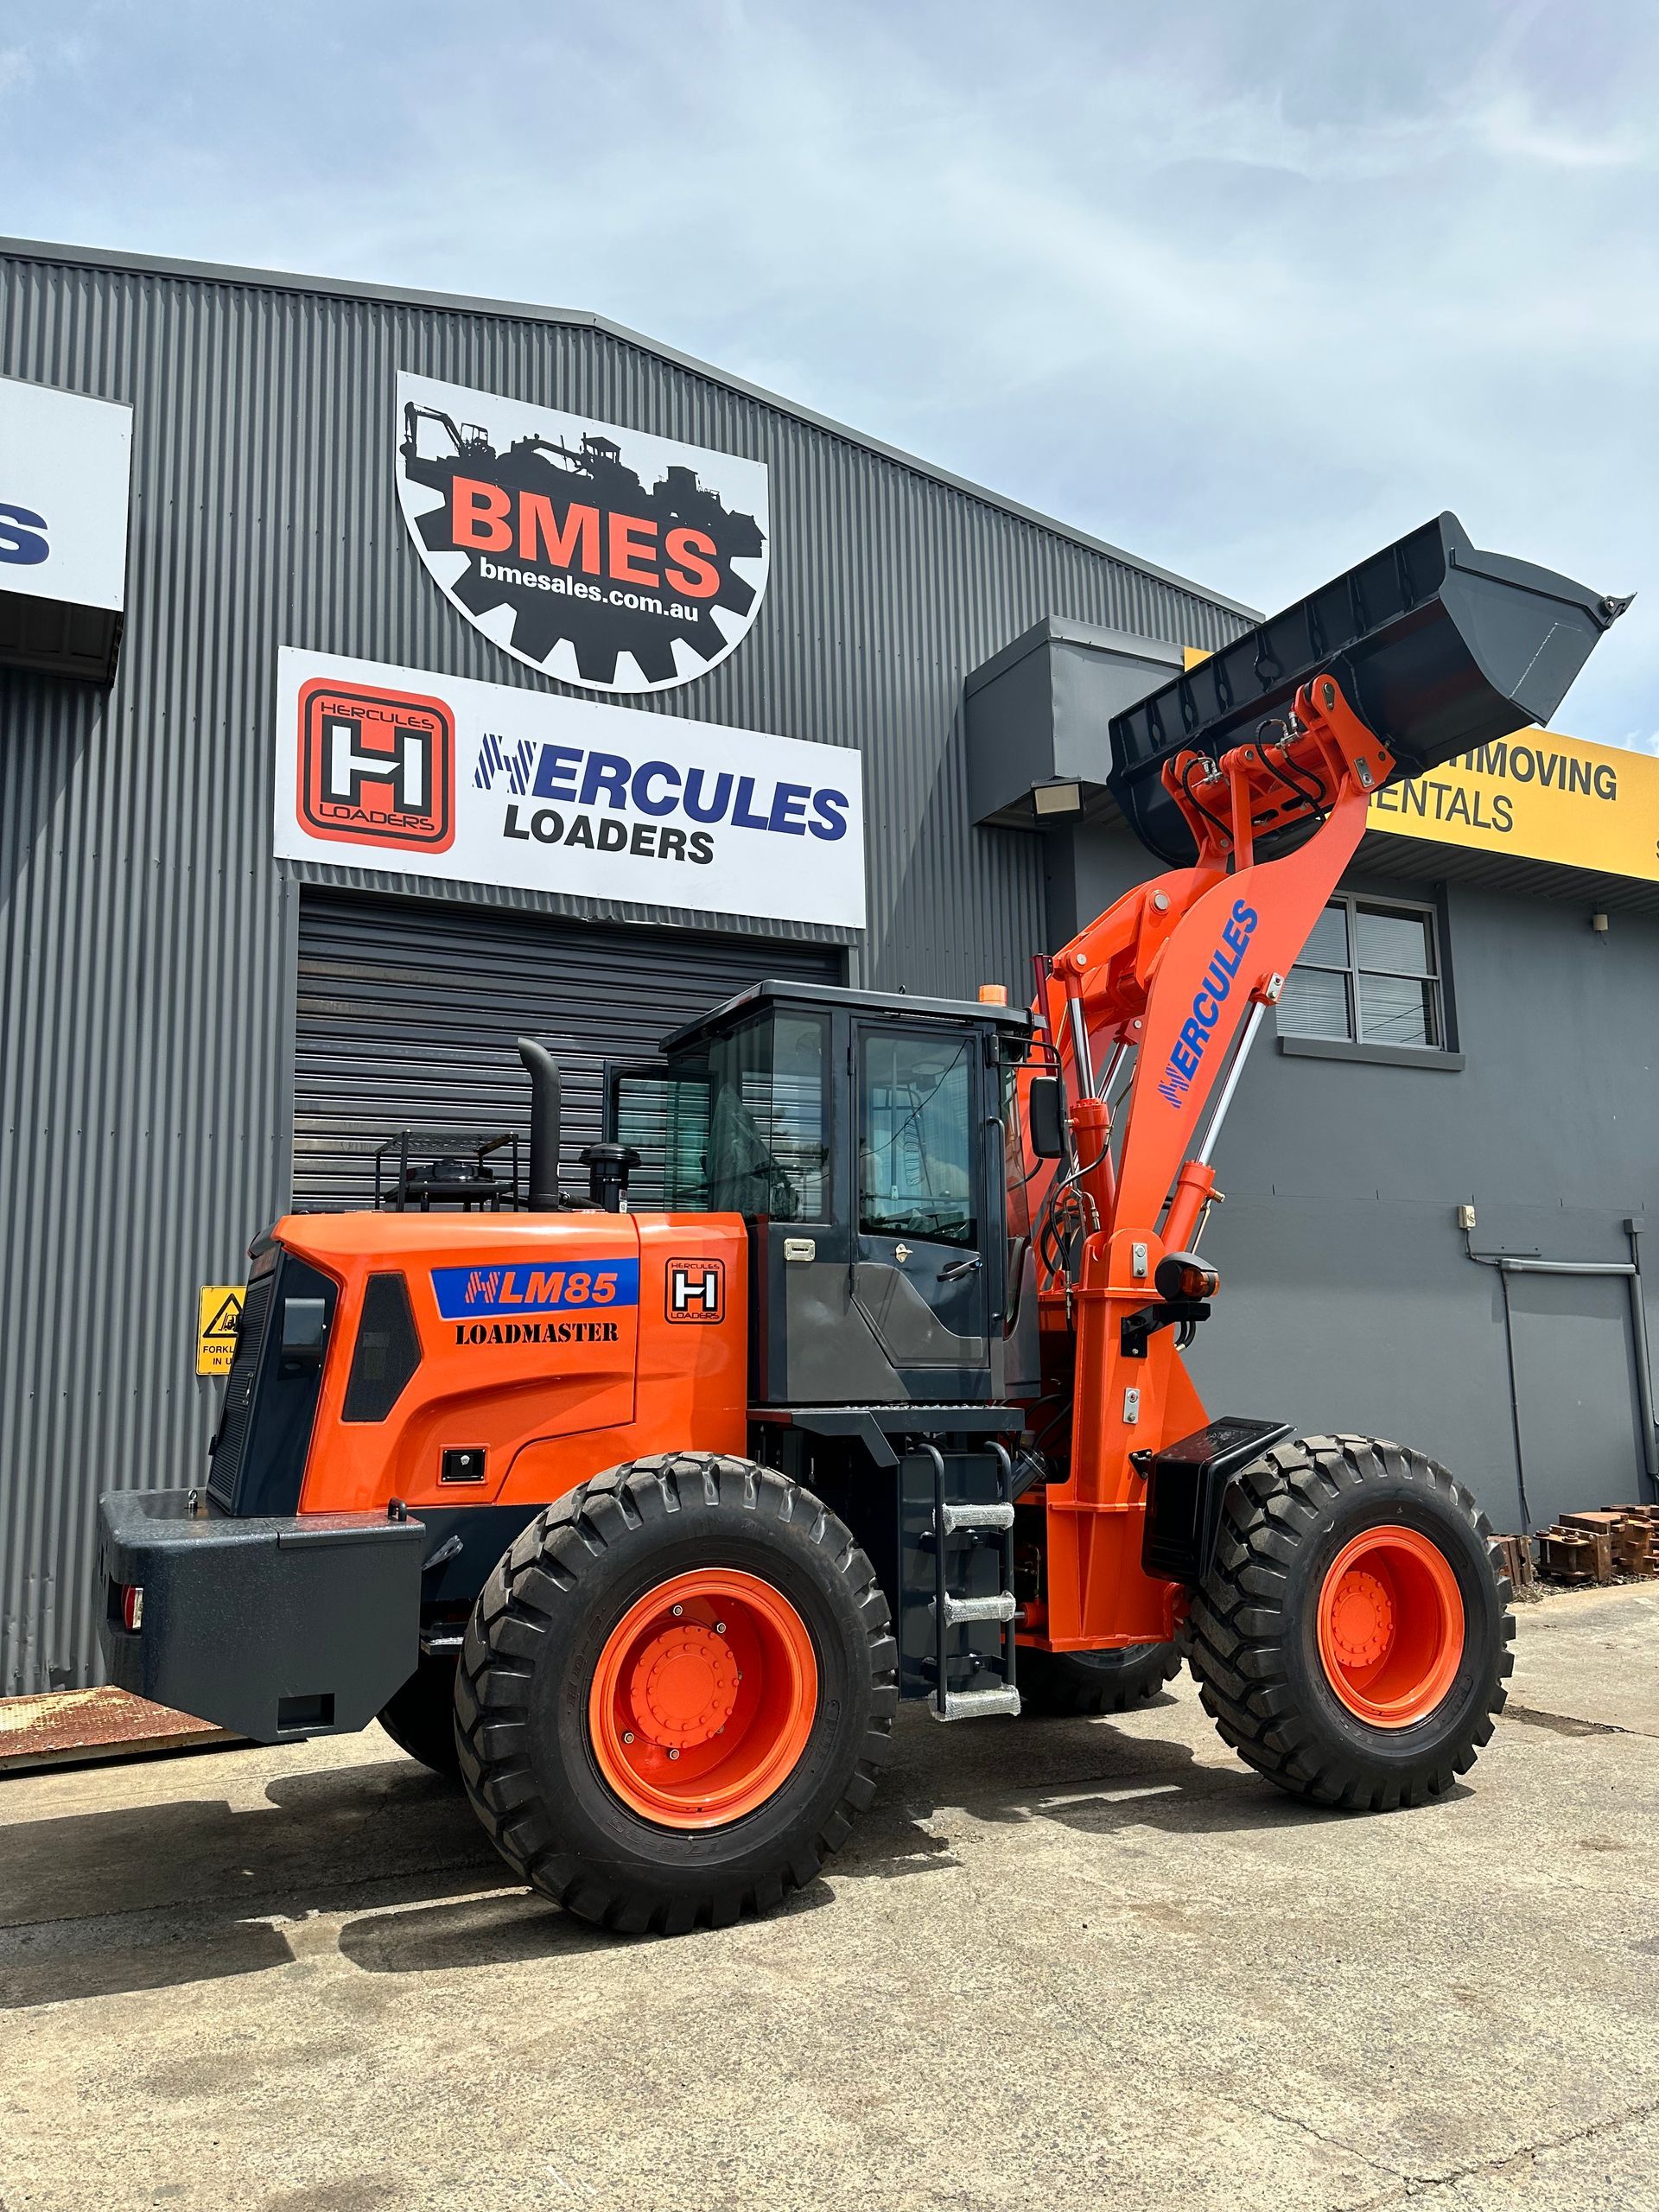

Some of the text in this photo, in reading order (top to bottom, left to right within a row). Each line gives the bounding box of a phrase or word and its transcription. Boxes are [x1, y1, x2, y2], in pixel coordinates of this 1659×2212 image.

[452, 475, 721, 598] BMES
[480, 556, 699, 622] bmesales.com.au
[321, 702, 435, 730] HERCULES
[321, 714, 433, 817] H
[472, 733, 849, 841] HERCULES
[320, 803, 435, 831] LOADERS
[503, 804, 715, 865] LOADERS
[1368, 779, 1514, 833] ENTALS
[1157, 899, 1258, 1109] HERCULES
[455, 1322, 620, 1345] LOADMASTER
